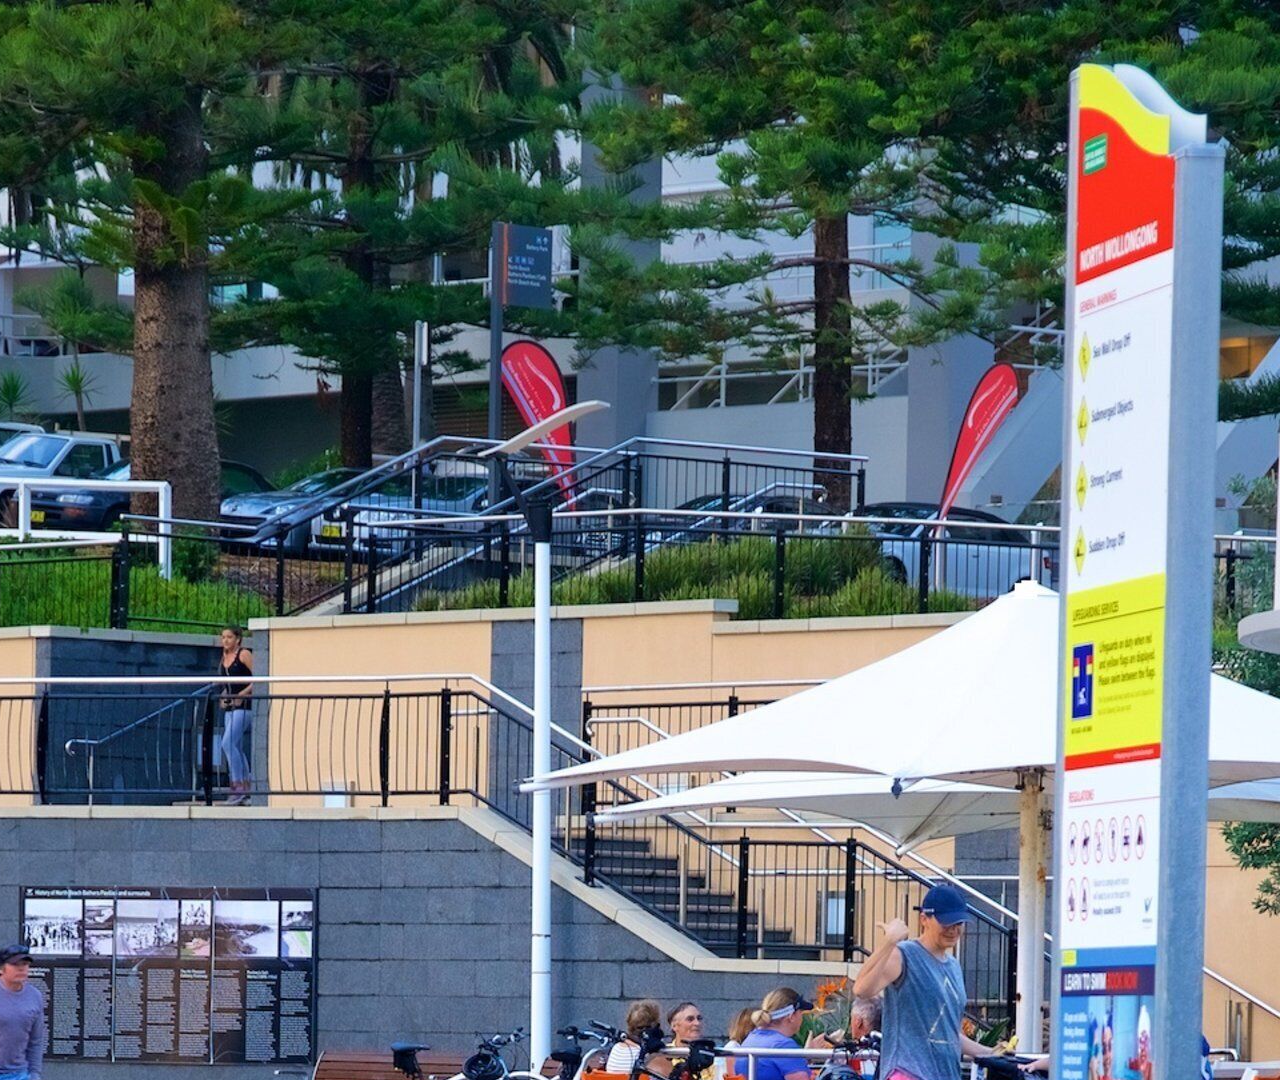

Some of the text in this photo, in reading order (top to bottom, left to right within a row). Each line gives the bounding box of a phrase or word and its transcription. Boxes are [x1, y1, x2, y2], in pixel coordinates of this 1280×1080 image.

[1080, 220, 1158, 272] NORTH WOLLONGONG
[1093, 346, 1101, 358] Sea
[1112, 339, 1123, 353] Drop
[1091, 400, 1134, 423] Submerged Objects
[1090, 469, 1123, 488] Strong Current
[1089, 539, 1105, 553] Sudden
[1106, 536, 1117, 550] Drop
[1073, 601, 1119, 621] LIFEGUARDING SERVICES
[1065, 973, 1082, 991] LEARN
[1082, 973, 1090, 990] TO
[1090, 973, 1106, 990] SWIM
